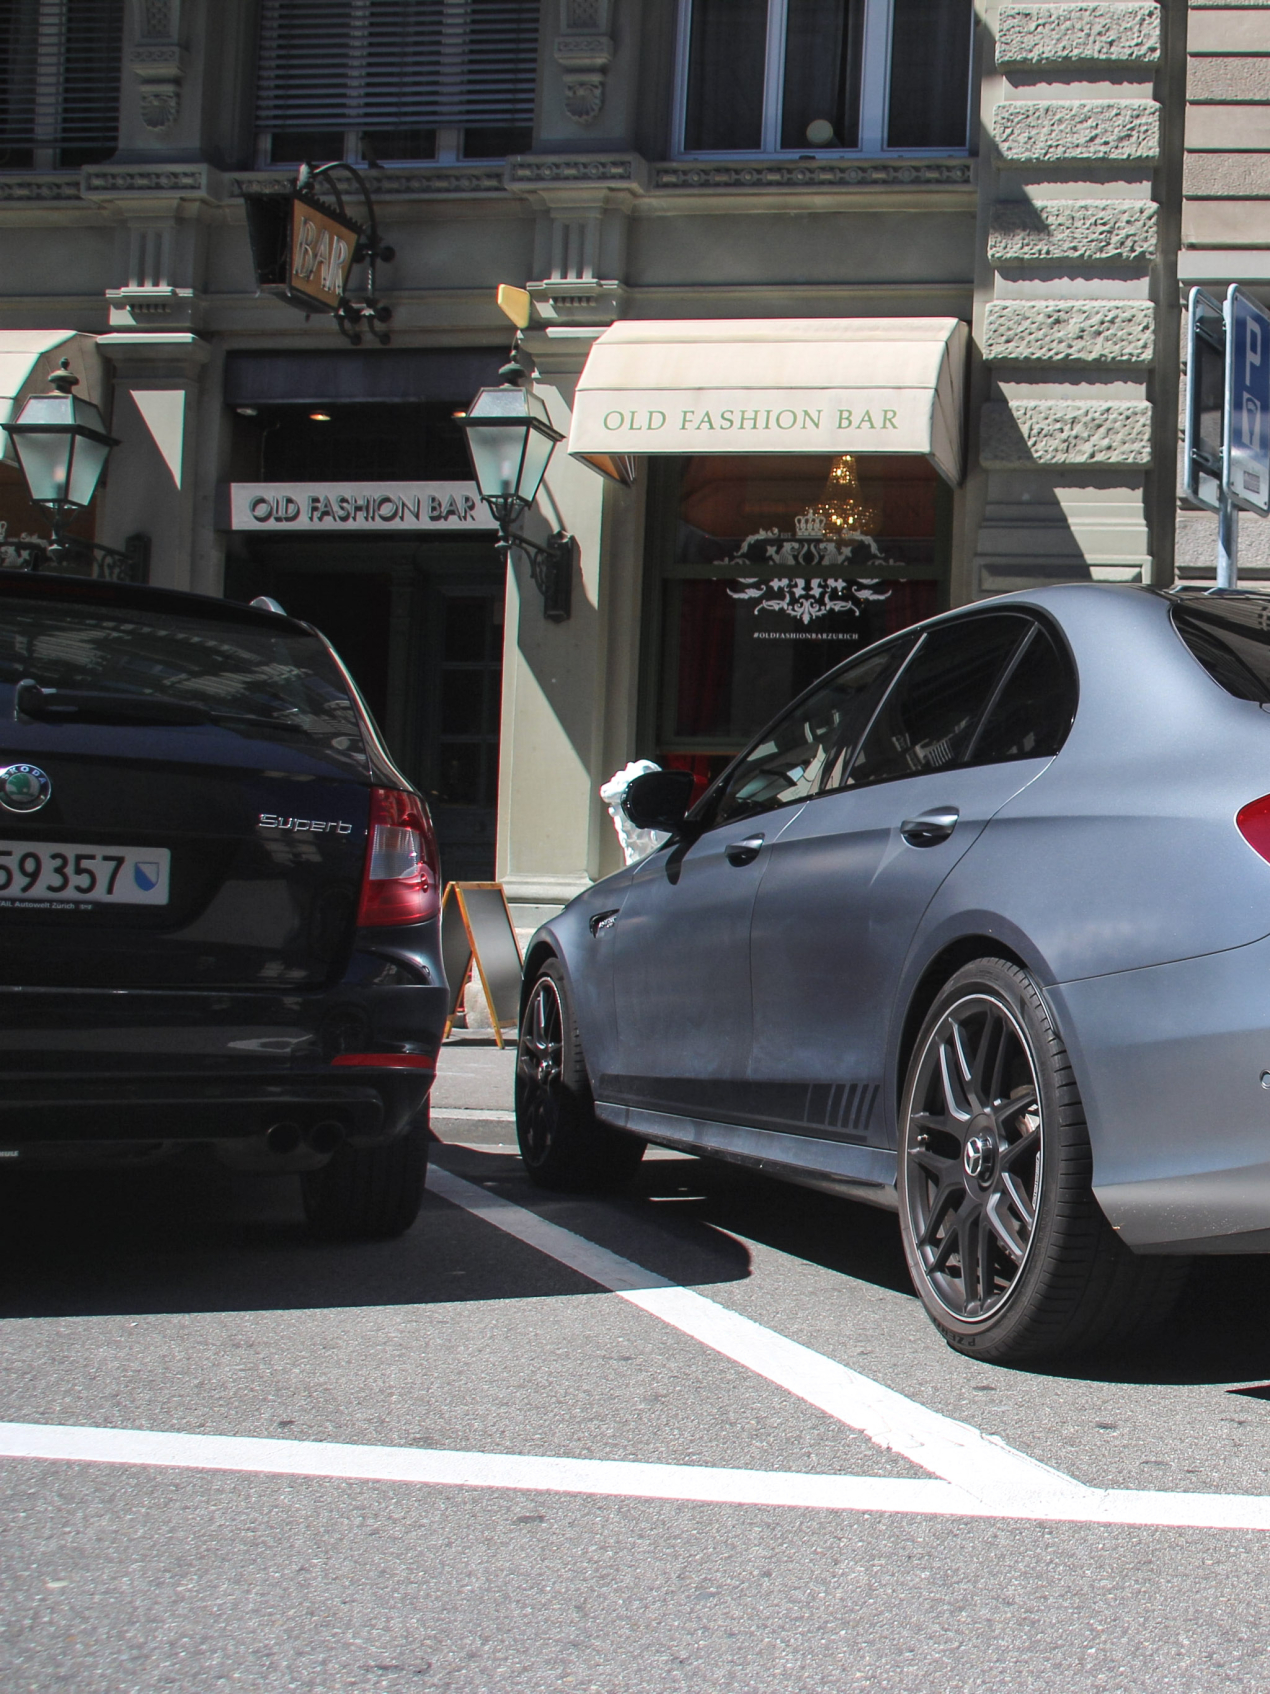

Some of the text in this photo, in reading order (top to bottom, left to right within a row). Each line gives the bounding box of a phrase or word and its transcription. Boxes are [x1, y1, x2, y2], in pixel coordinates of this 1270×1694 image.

[293, 216, 348, 297] BAR
[1245, 316, 1261, 387] P
[603, 409, 898, 431] OLD FASHION BAR
[249, 494, 476, 523] OLD FASHION BAR
[753, 632, 859, 640] #OLDFASHIONBARZURICH
[258, 813, 353, 834] Superb
